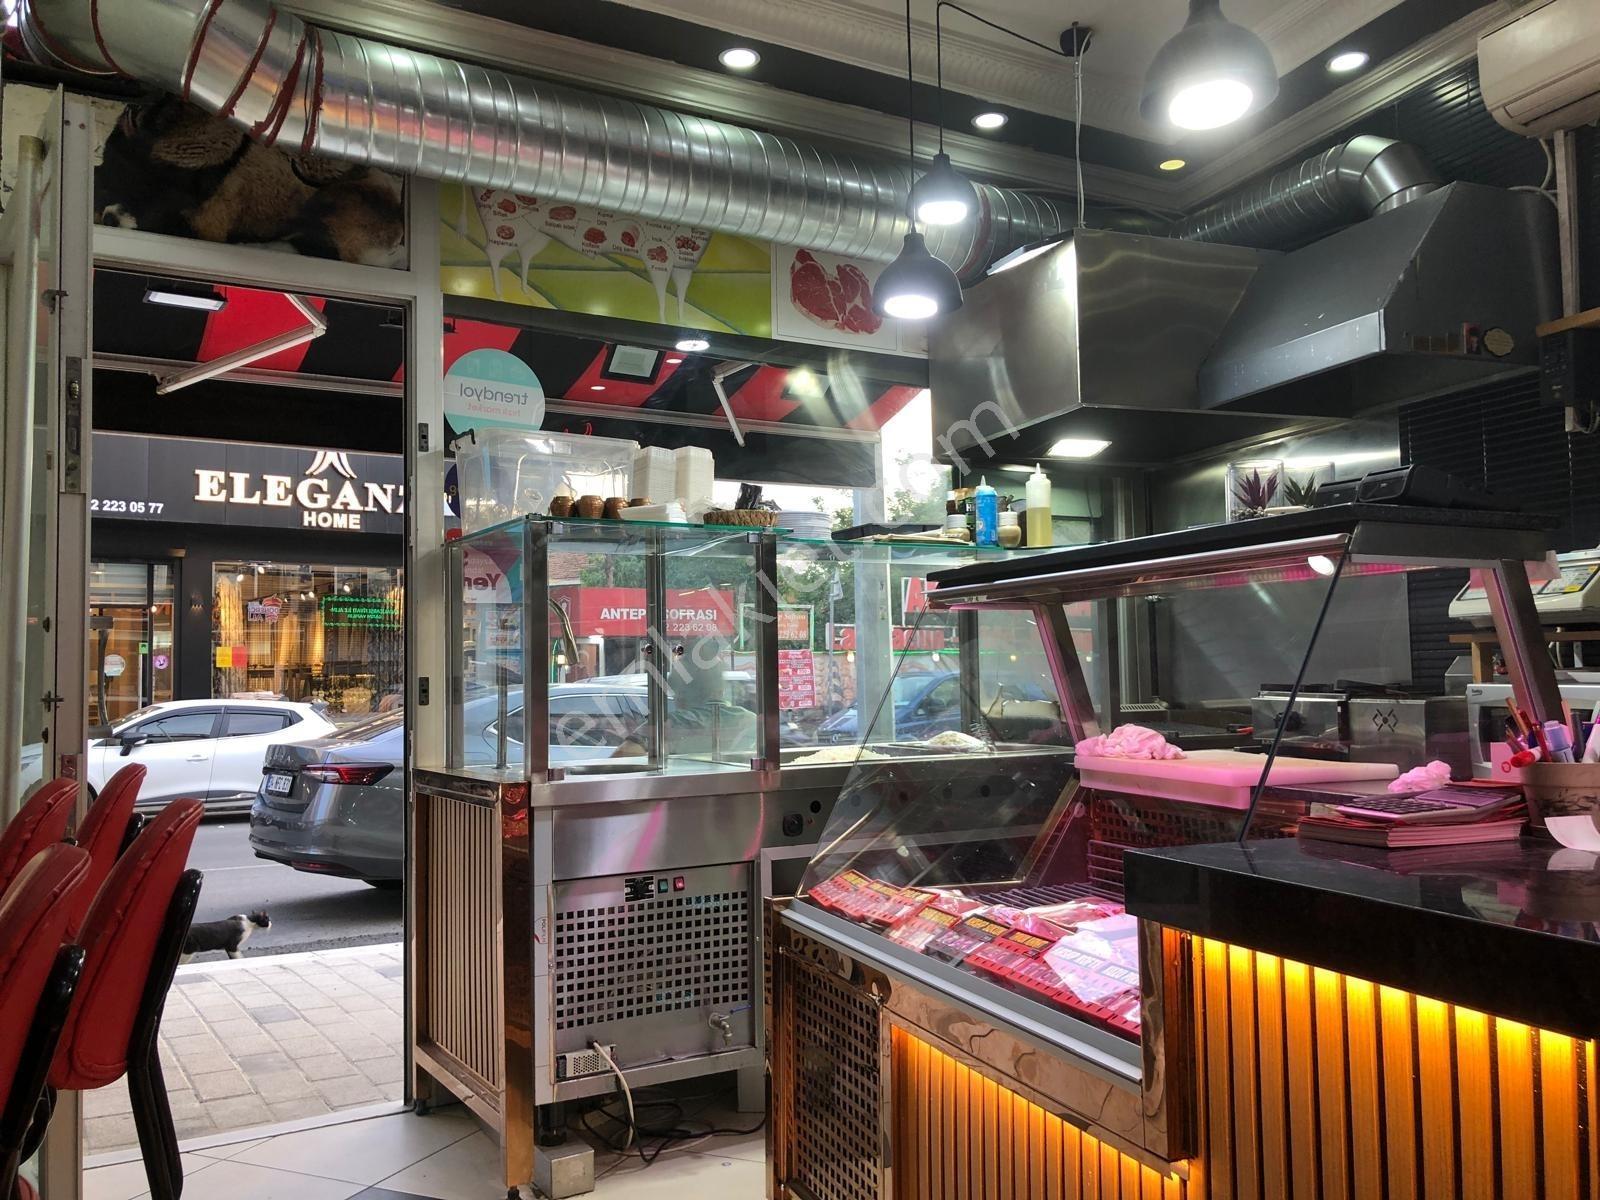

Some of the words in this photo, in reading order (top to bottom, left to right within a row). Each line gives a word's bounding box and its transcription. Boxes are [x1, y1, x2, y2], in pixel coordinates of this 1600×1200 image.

[194, 468, 404, 514] ELEGAN
[102, 499, 127, 512] 223
[129, 501, 145, 513] 05
[148, 502, 164, 514] 77
[303, 511, 361, 530] HOME
[600, 607, 647, 620] ANTEP
[673, 623, 691, 632] 223
[692, 623, 704, 632] 62
[706, 623, 717, 632] 08
